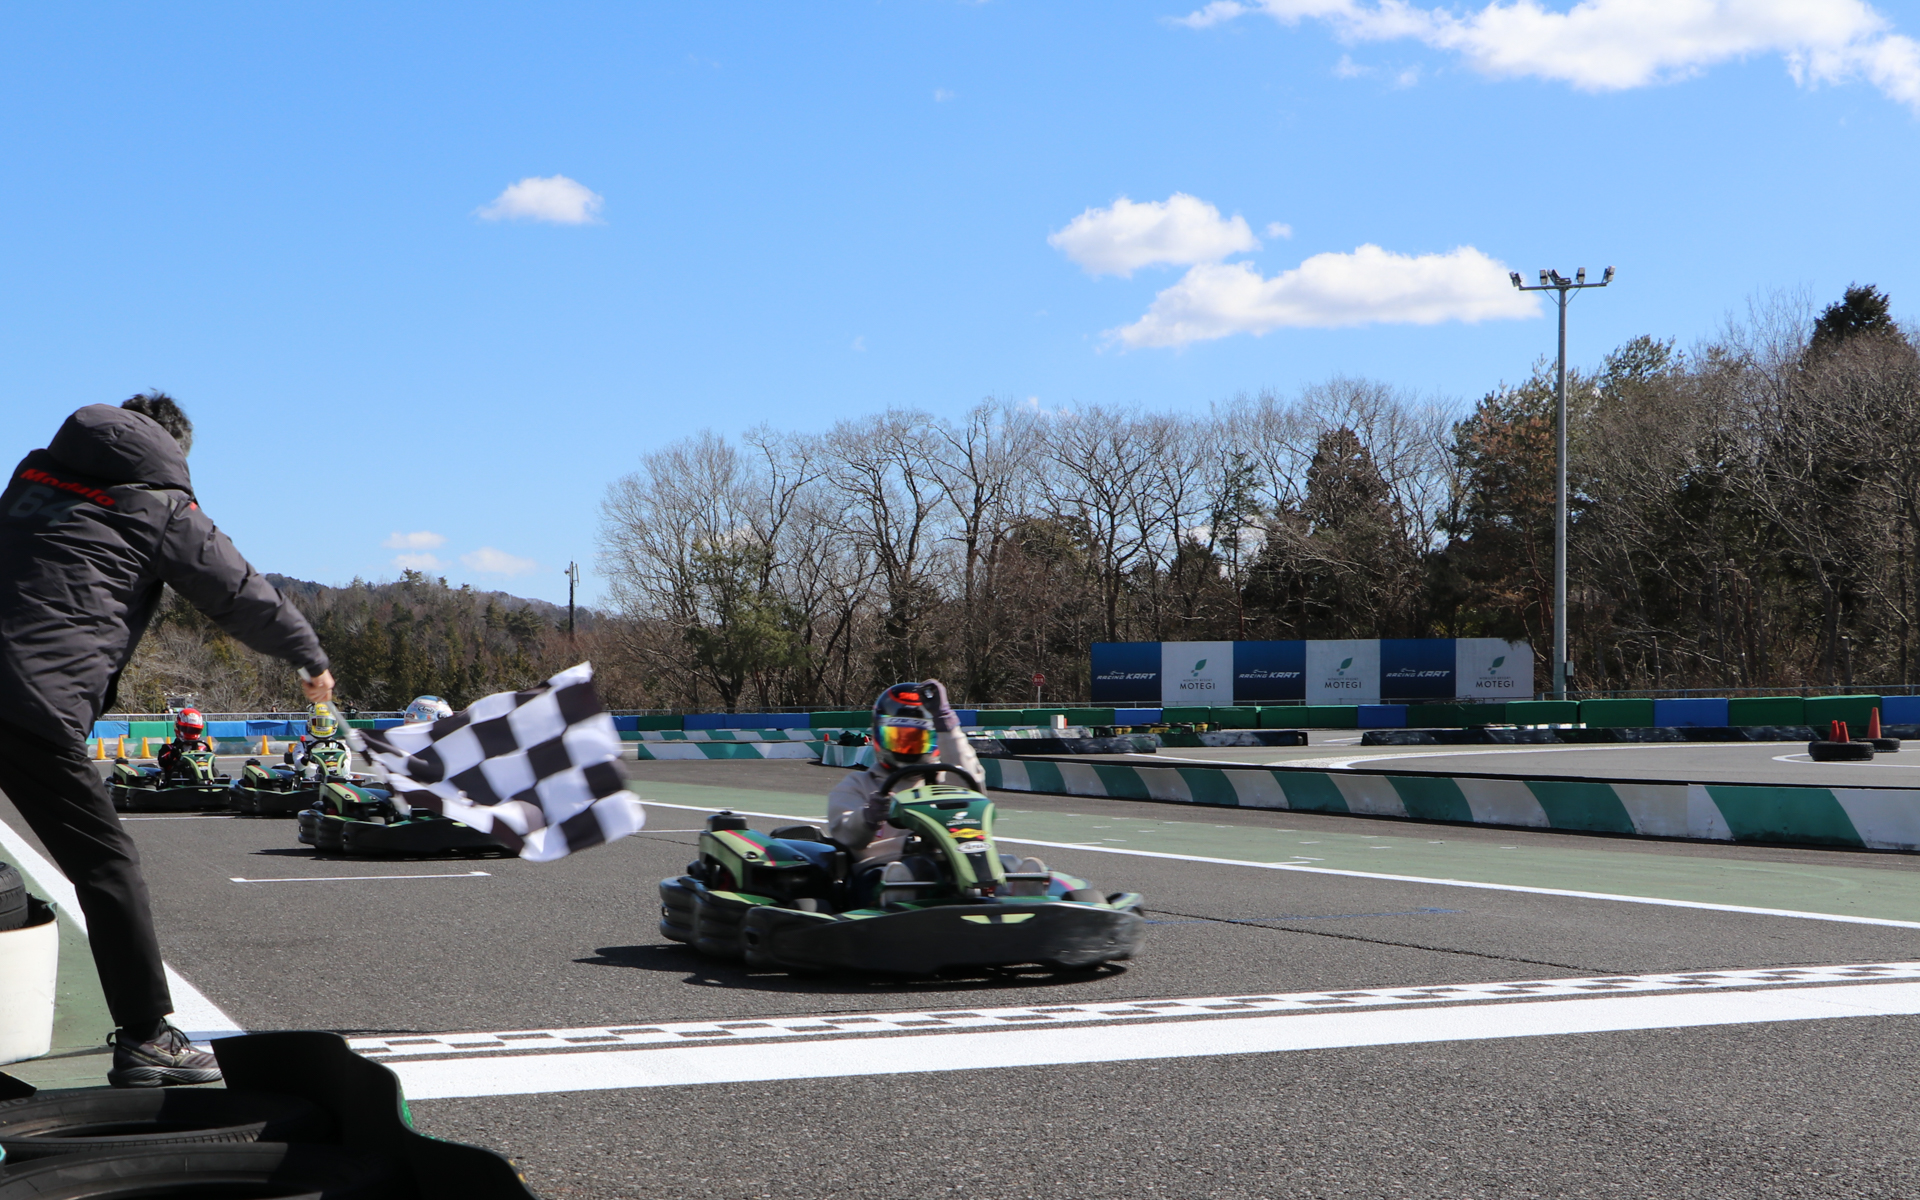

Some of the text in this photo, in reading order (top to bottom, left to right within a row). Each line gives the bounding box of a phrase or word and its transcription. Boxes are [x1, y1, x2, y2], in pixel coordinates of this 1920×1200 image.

[20, 468, 116, 506] Modulo
[8, 484, 83, 527] 64
[1125, 672, 1157, 680] KART
[1268, 671, 1301, 679] KART
[1416, 670, 1450, 678] KART
[1179, 682, 1216, 690] MOTEGI
[1324, 681, 1362, 689] MOTEGI
[1475, 680, 1514, 688] MOTEGI
